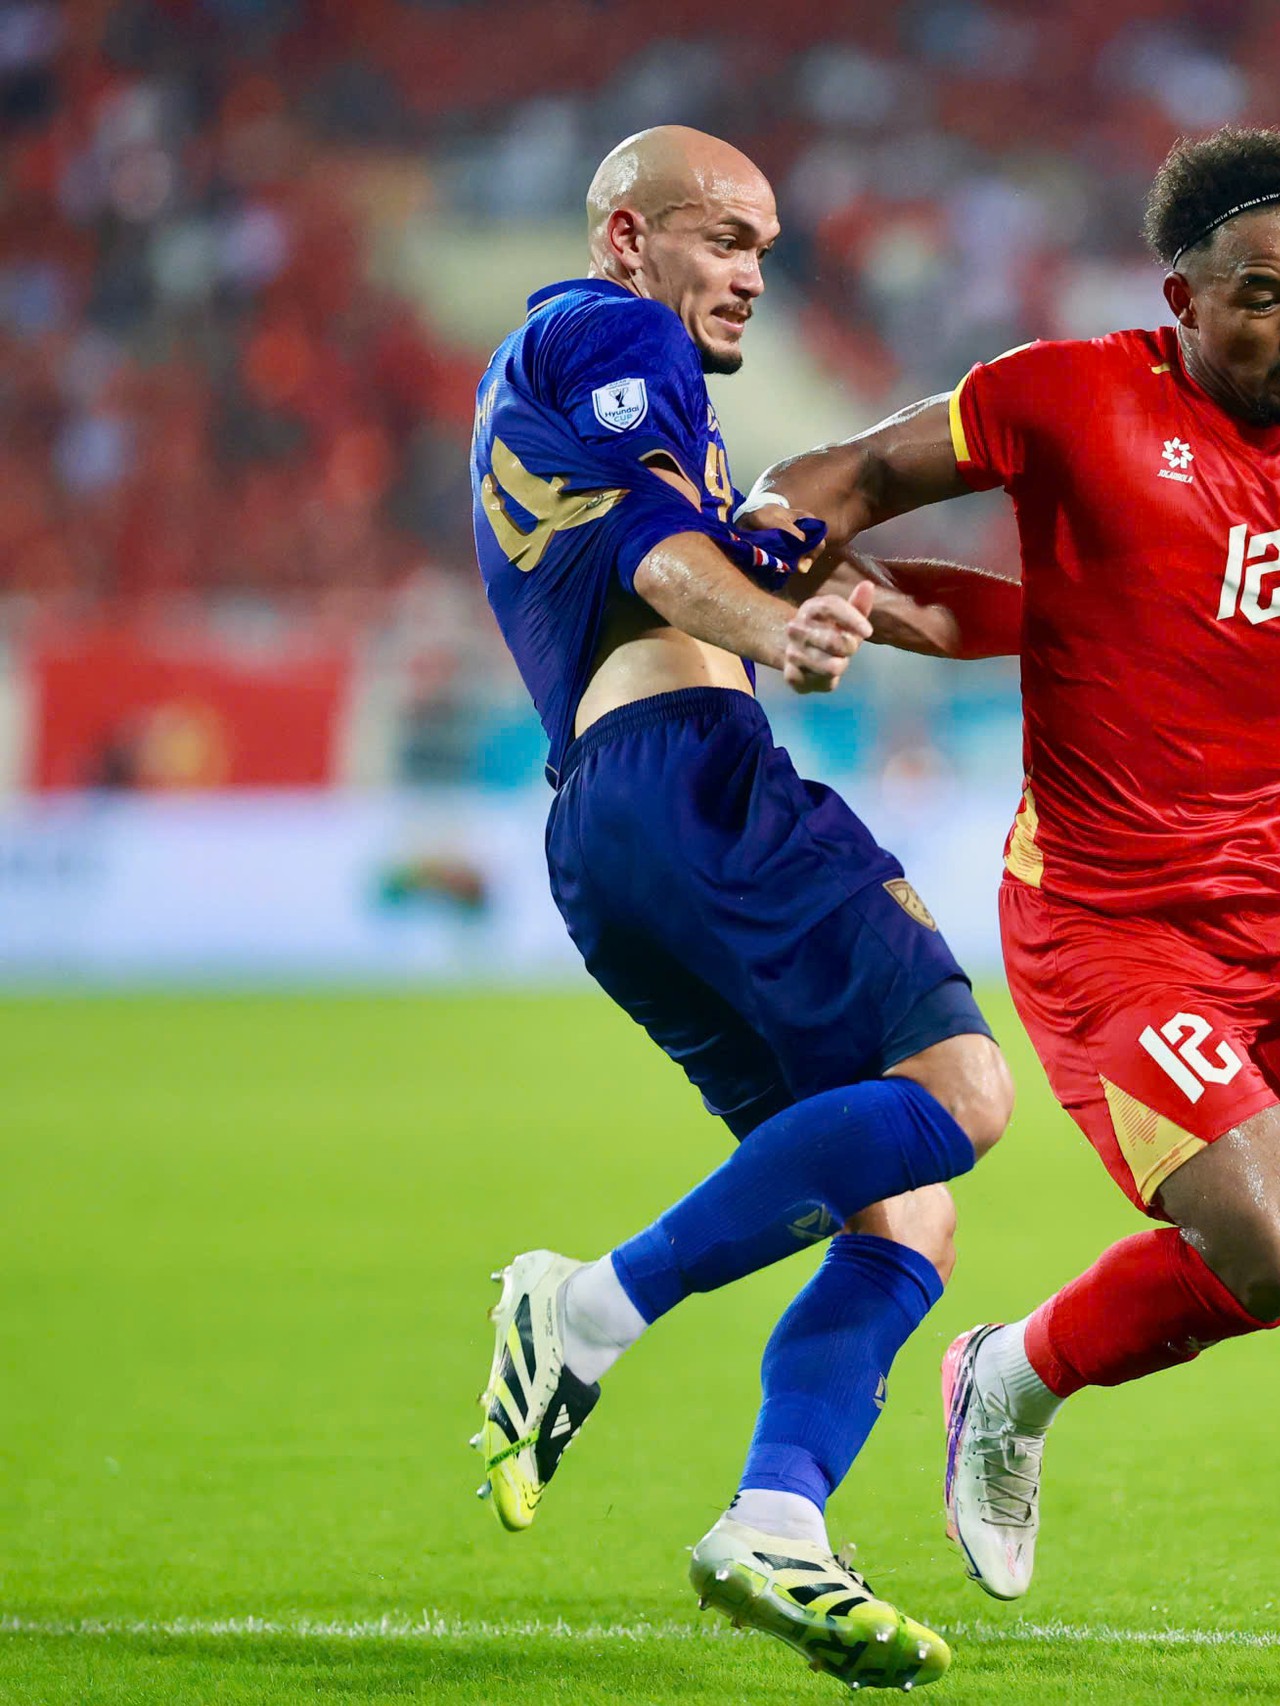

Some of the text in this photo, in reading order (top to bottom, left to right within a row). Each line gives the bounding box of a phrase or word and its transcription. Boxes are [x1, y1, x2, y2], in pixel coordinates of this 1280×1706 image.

[604, 405, 640, 418] Hyundai
[613, 413, 633, 422] CUP
[1138, 1012, 1243, 1105] 12
